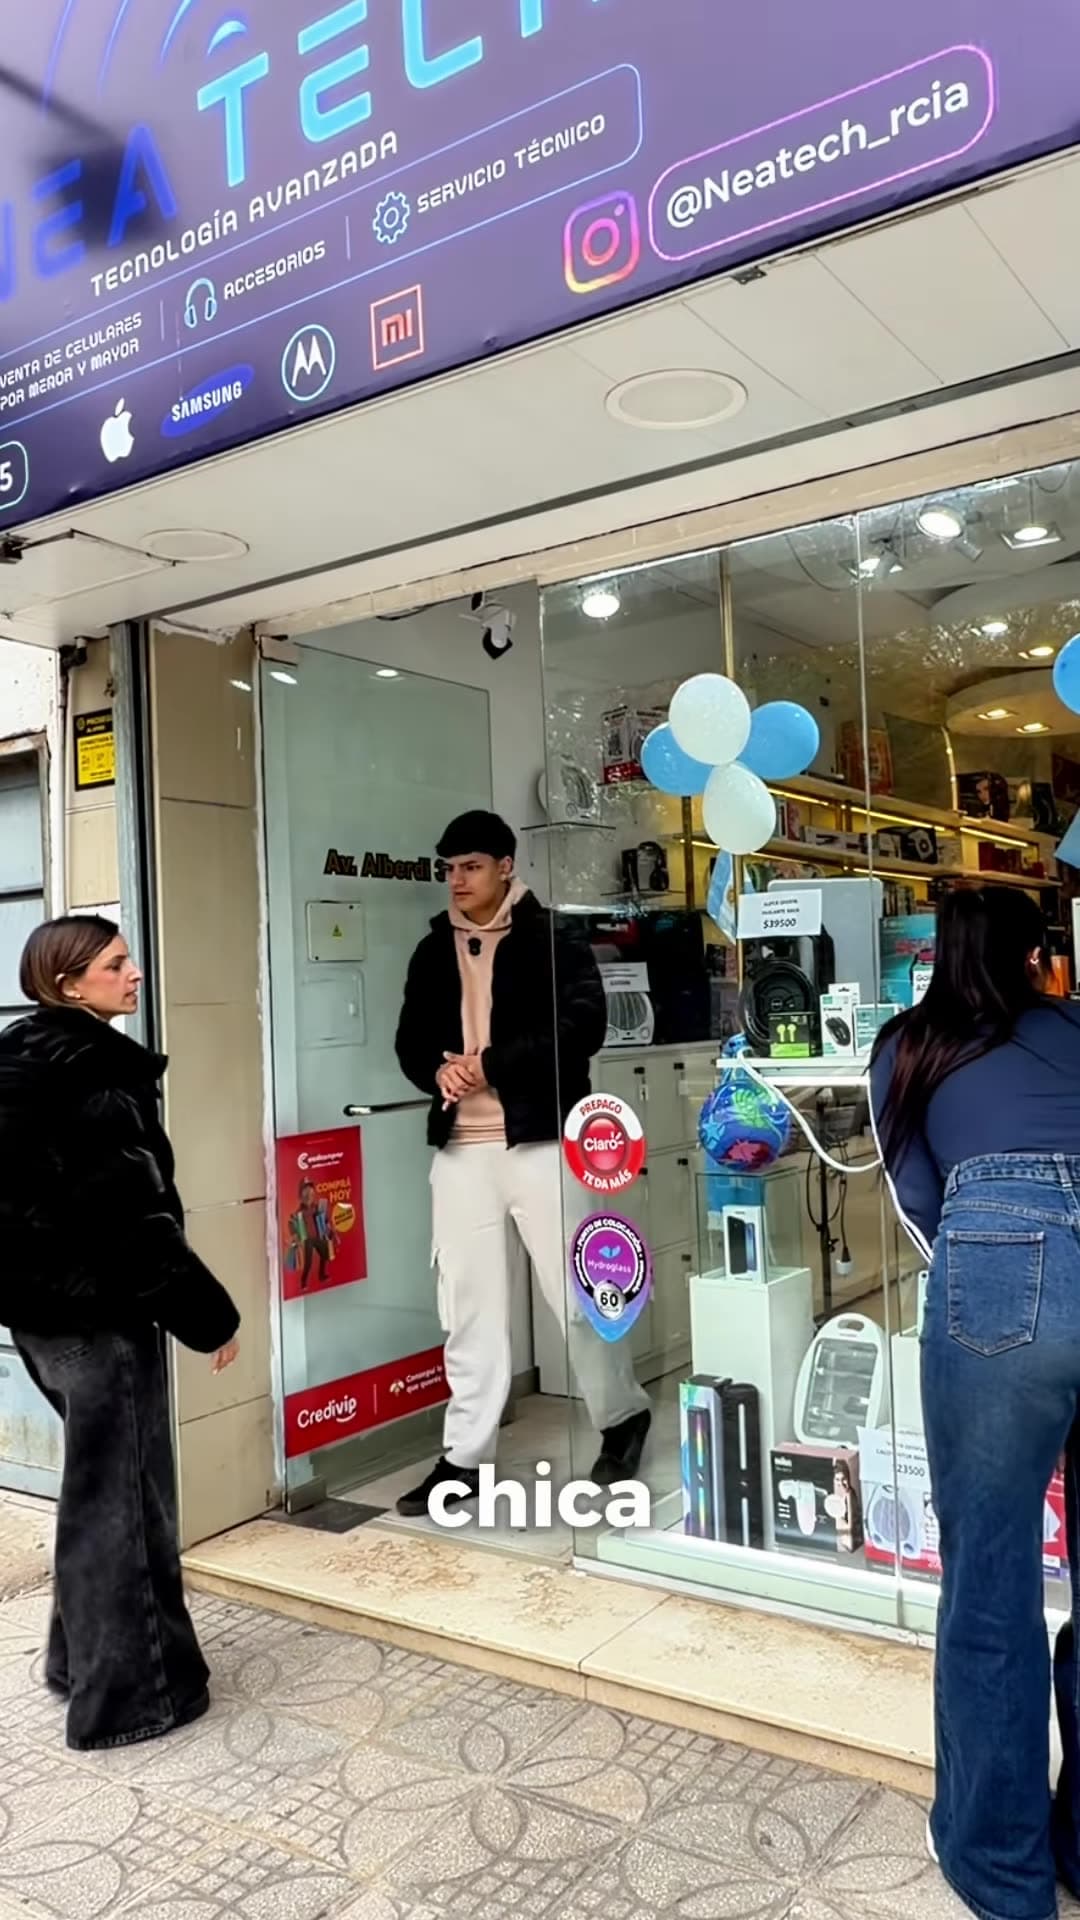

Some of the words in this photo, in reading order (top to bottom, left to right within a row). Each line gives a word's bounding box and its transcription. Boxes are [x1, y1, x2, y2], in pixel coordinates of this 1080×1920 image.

[416, 158, 506, 214] SERVICIO
[514, 113, 606, 170] TÉCNICO
[666, 80, 969, 229] @Neatech_rcia
[91, 209, 238, 297] TECNOLOGÍA
[249, 130, 398, 223] AVANZADA
[224, 241, 326, 301] ACCESORIOS
[0, 358, 41, 389] VENTA
[45, 348, 62, 369] DE
[65, 311, 143, 359] CELULARES
[0, 387, 25, 411] POR
[29, 366, 73, 399] MENOR
[77, 360, 87, 377] Y
[91, 337, 140, 372] MAYOR
[171, 380, 243, 423] SAMSUNG
[323, 848, 358, 876] Av.
[360, 851, 431, 882] Alberdi
[580, 1099, 622, 1116] PREPAGO
[583, 1137, 620, 1153] Claro
[582, 1170, 595, 1186] TE
[595, 1178, 609, 1190] DA
[609, 1168, 633, 1190] MÁS
[587, 1259, 632, 1273] Hydroglass
[600, 1292, 619, 1307] 60
[297, 1395, 358, 1428] Credivip
